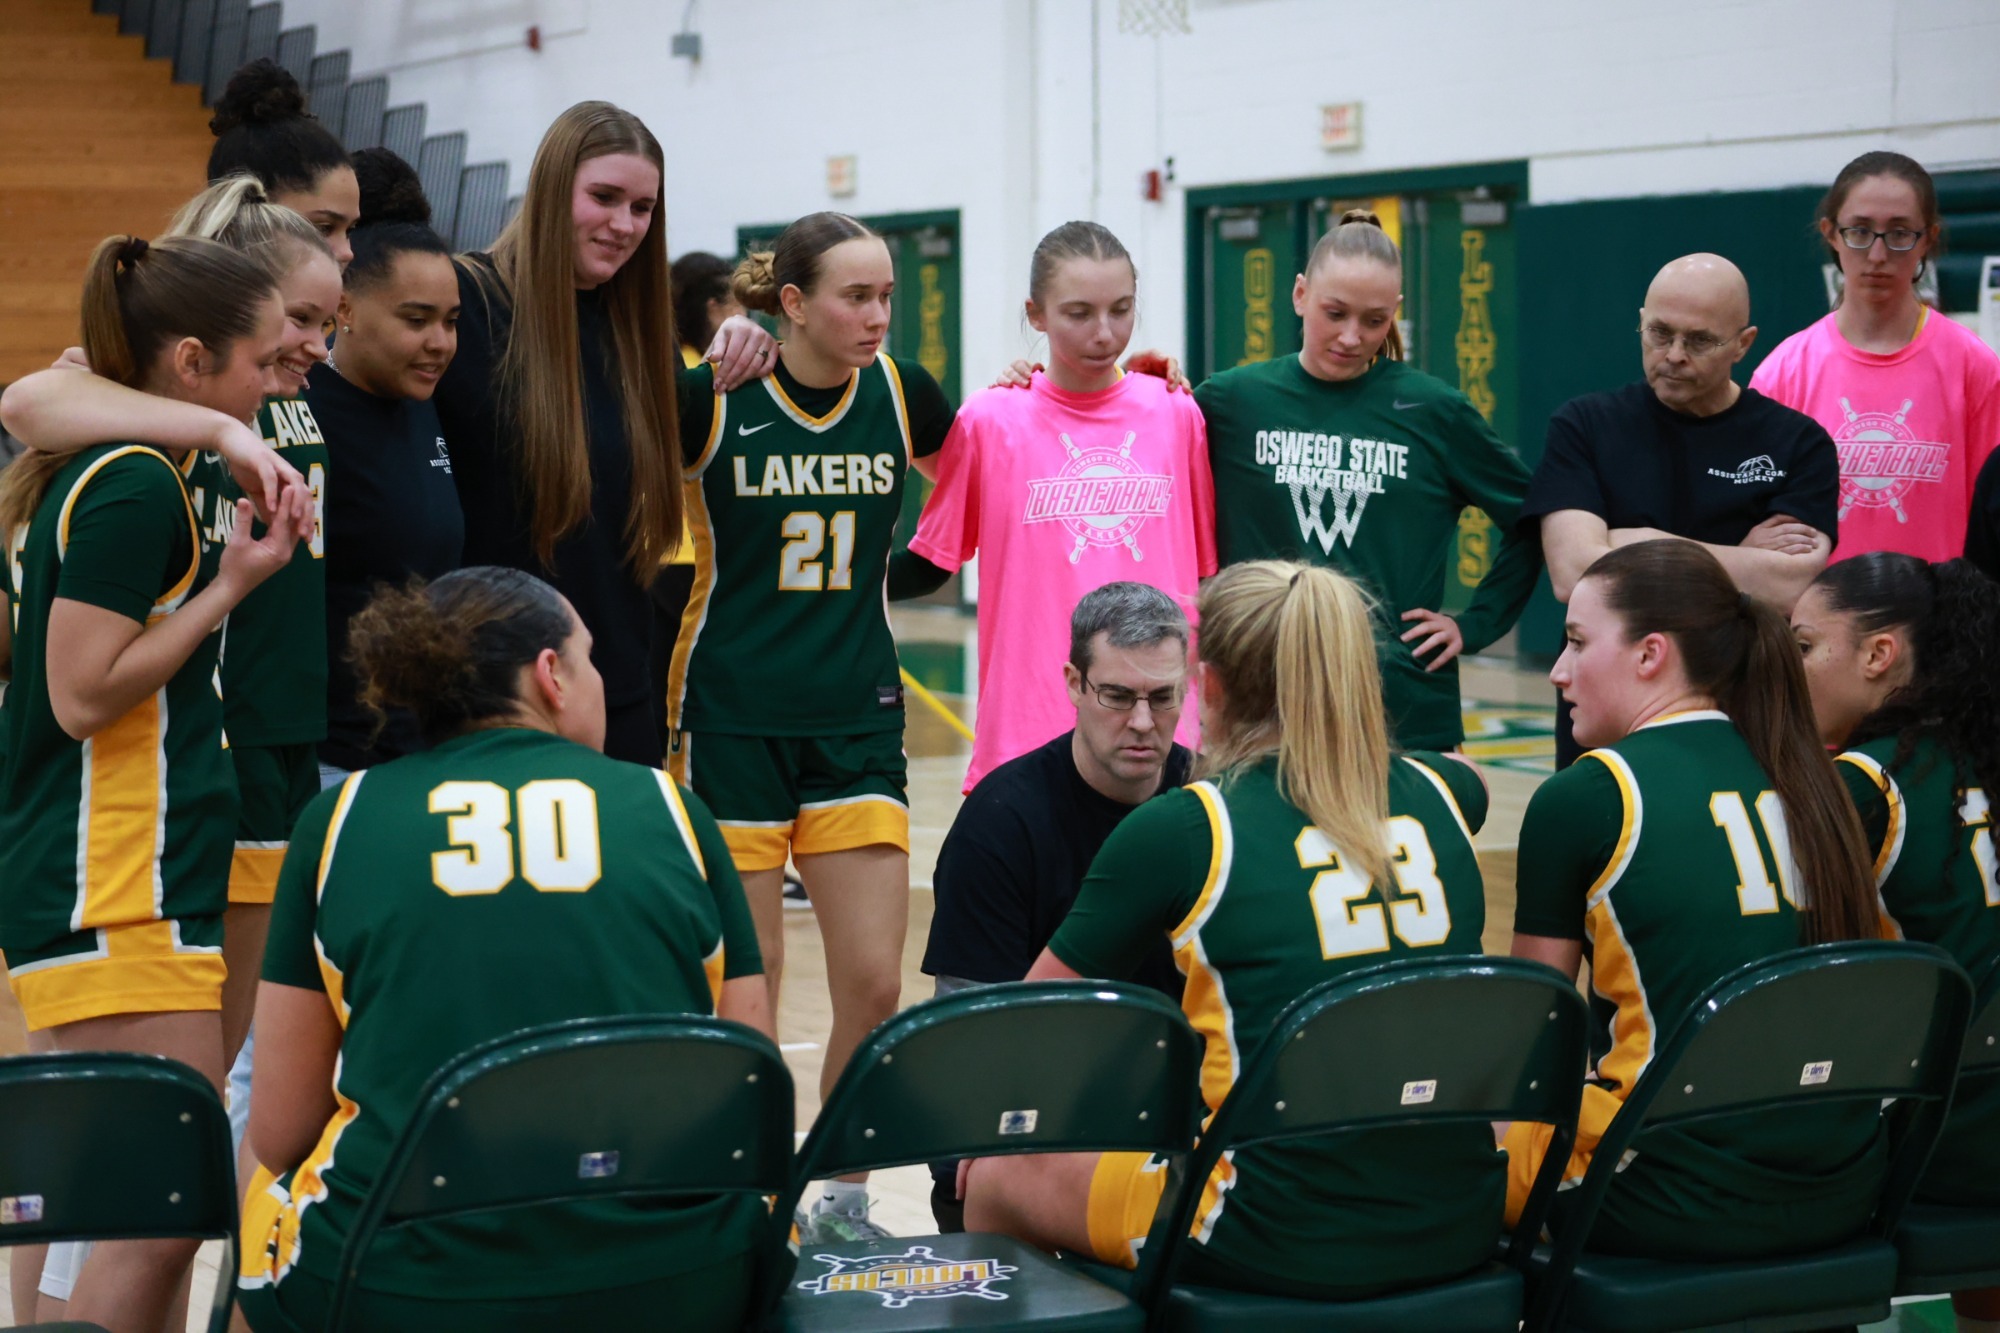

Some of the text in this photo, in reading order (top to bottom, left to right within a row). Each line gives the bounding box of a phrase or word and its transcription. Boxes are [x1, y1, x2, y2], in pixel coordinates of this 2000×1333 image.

[250, 401, 325, 450] LAKE
[733, 453, 895, 497] LAKERS
[1071, 455, 1131, 475] OSWEGO STATE
[1255, 430, 1409, 480] OSWEGO STATE
[1707, 467, 1761, 479] ASSISTANT
[1275, 464, 1386, 494] BASKETBALL
[778, 511, 855, 591] 21
[1074, 518, 1135, 540] LAKERS
[428, 779, 602, 897] 30
[1294, 815, 1452, 960] 23
[827, 1261, 991, 1292] LAKERS
